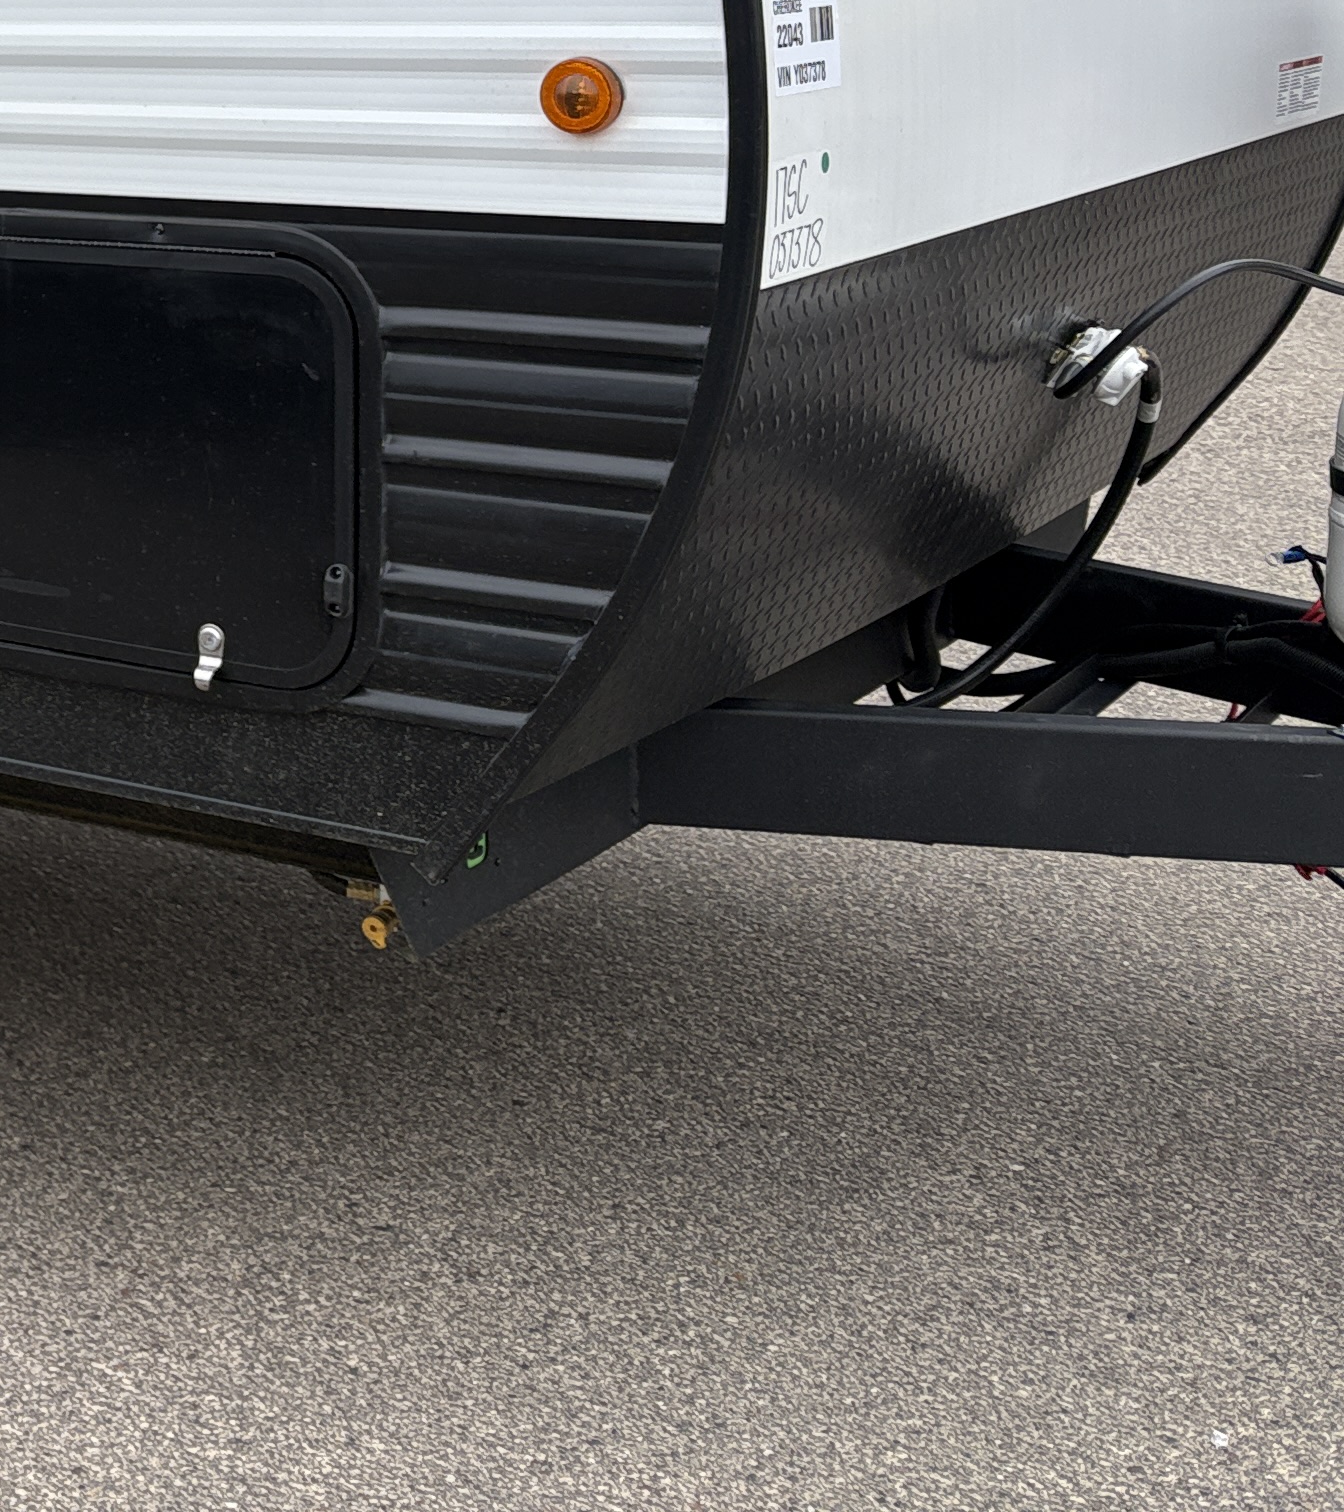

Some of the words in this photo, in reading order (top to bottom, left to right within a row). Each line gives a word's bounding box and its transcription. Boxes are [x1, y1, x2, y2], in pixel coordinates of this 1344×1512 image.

[777, 22, 804, 48] 22043
[777, 65, 792, 88] VIN
[773, 158, 809, 228] 17SC
[769, 217, 824, 280] 037378
